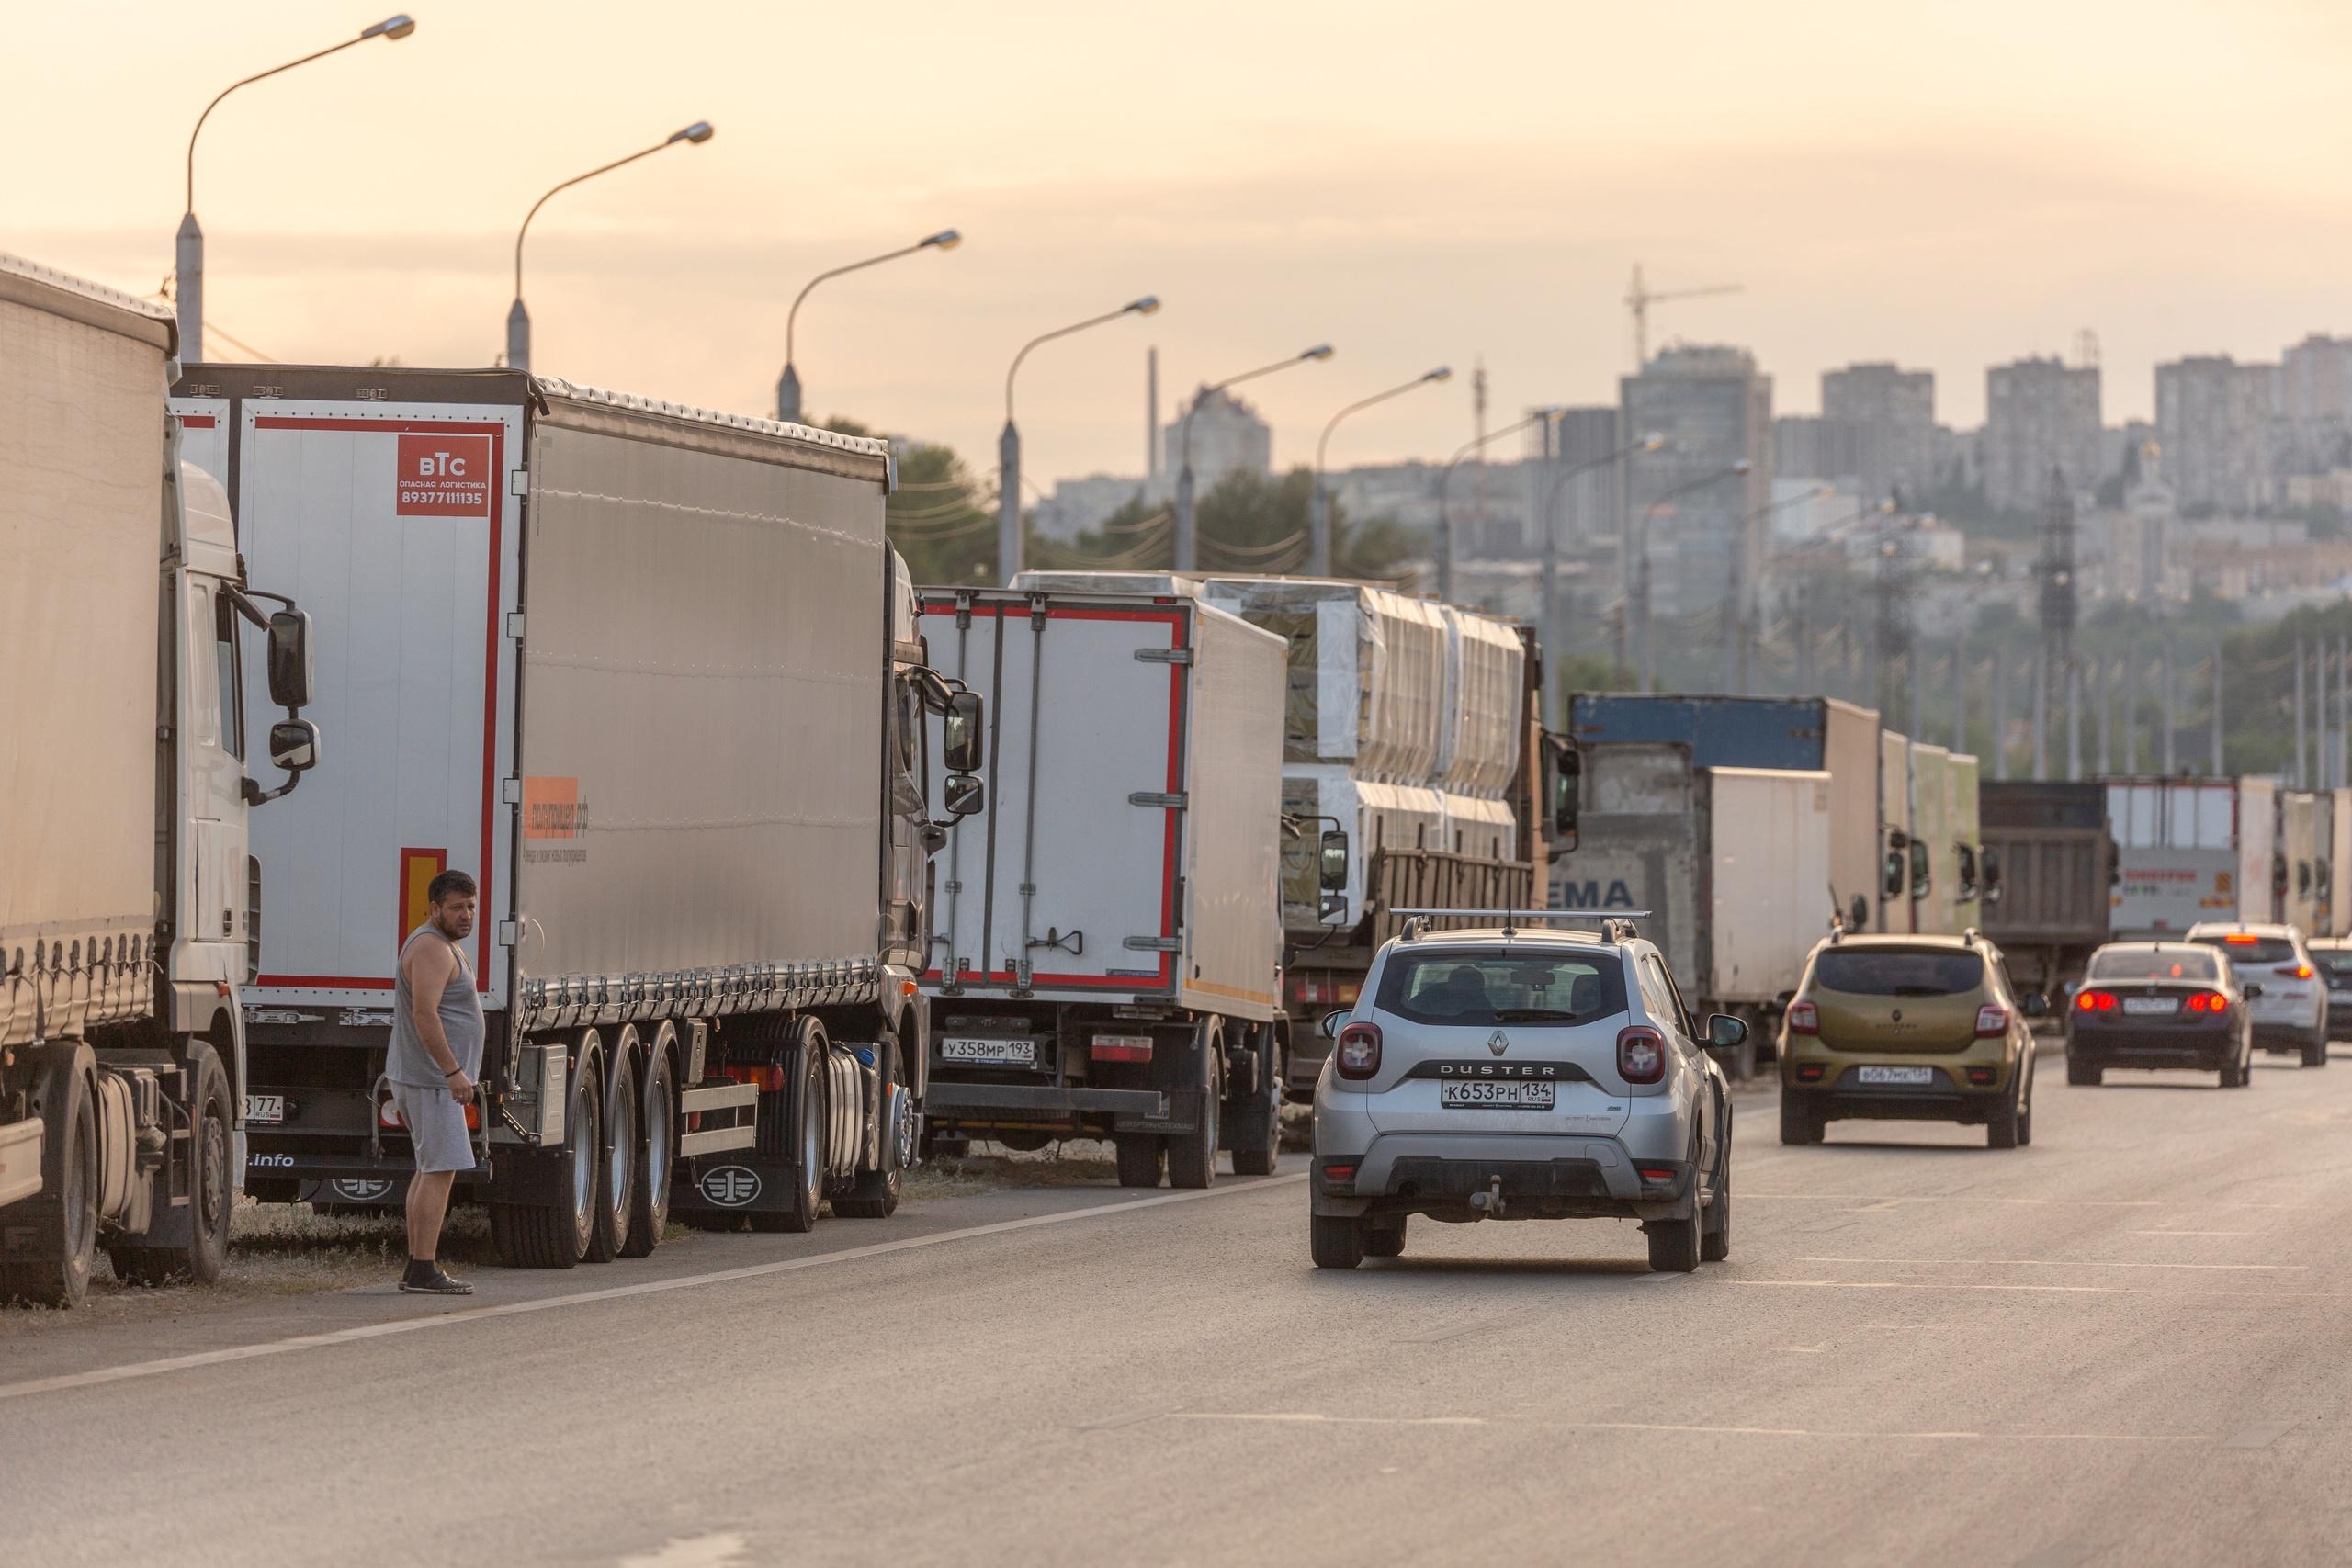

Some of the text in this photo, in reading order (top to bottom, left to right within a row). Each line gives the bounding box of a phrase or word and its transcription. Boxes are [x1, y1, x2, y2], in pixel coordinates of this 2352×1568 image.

[401, 491, 482, 505] 89377111135
[948, 1041, 1005, 1057] У358МР
[1009, 1043, 1030, 1055] 193
[1440, 1066, 1555, 1075] DUSTER
[1448, 1083, 1548, 1100] К653РН 134
[257, 1097, 276, 1111] 77
[246, 1153, 295, 1167] .info
